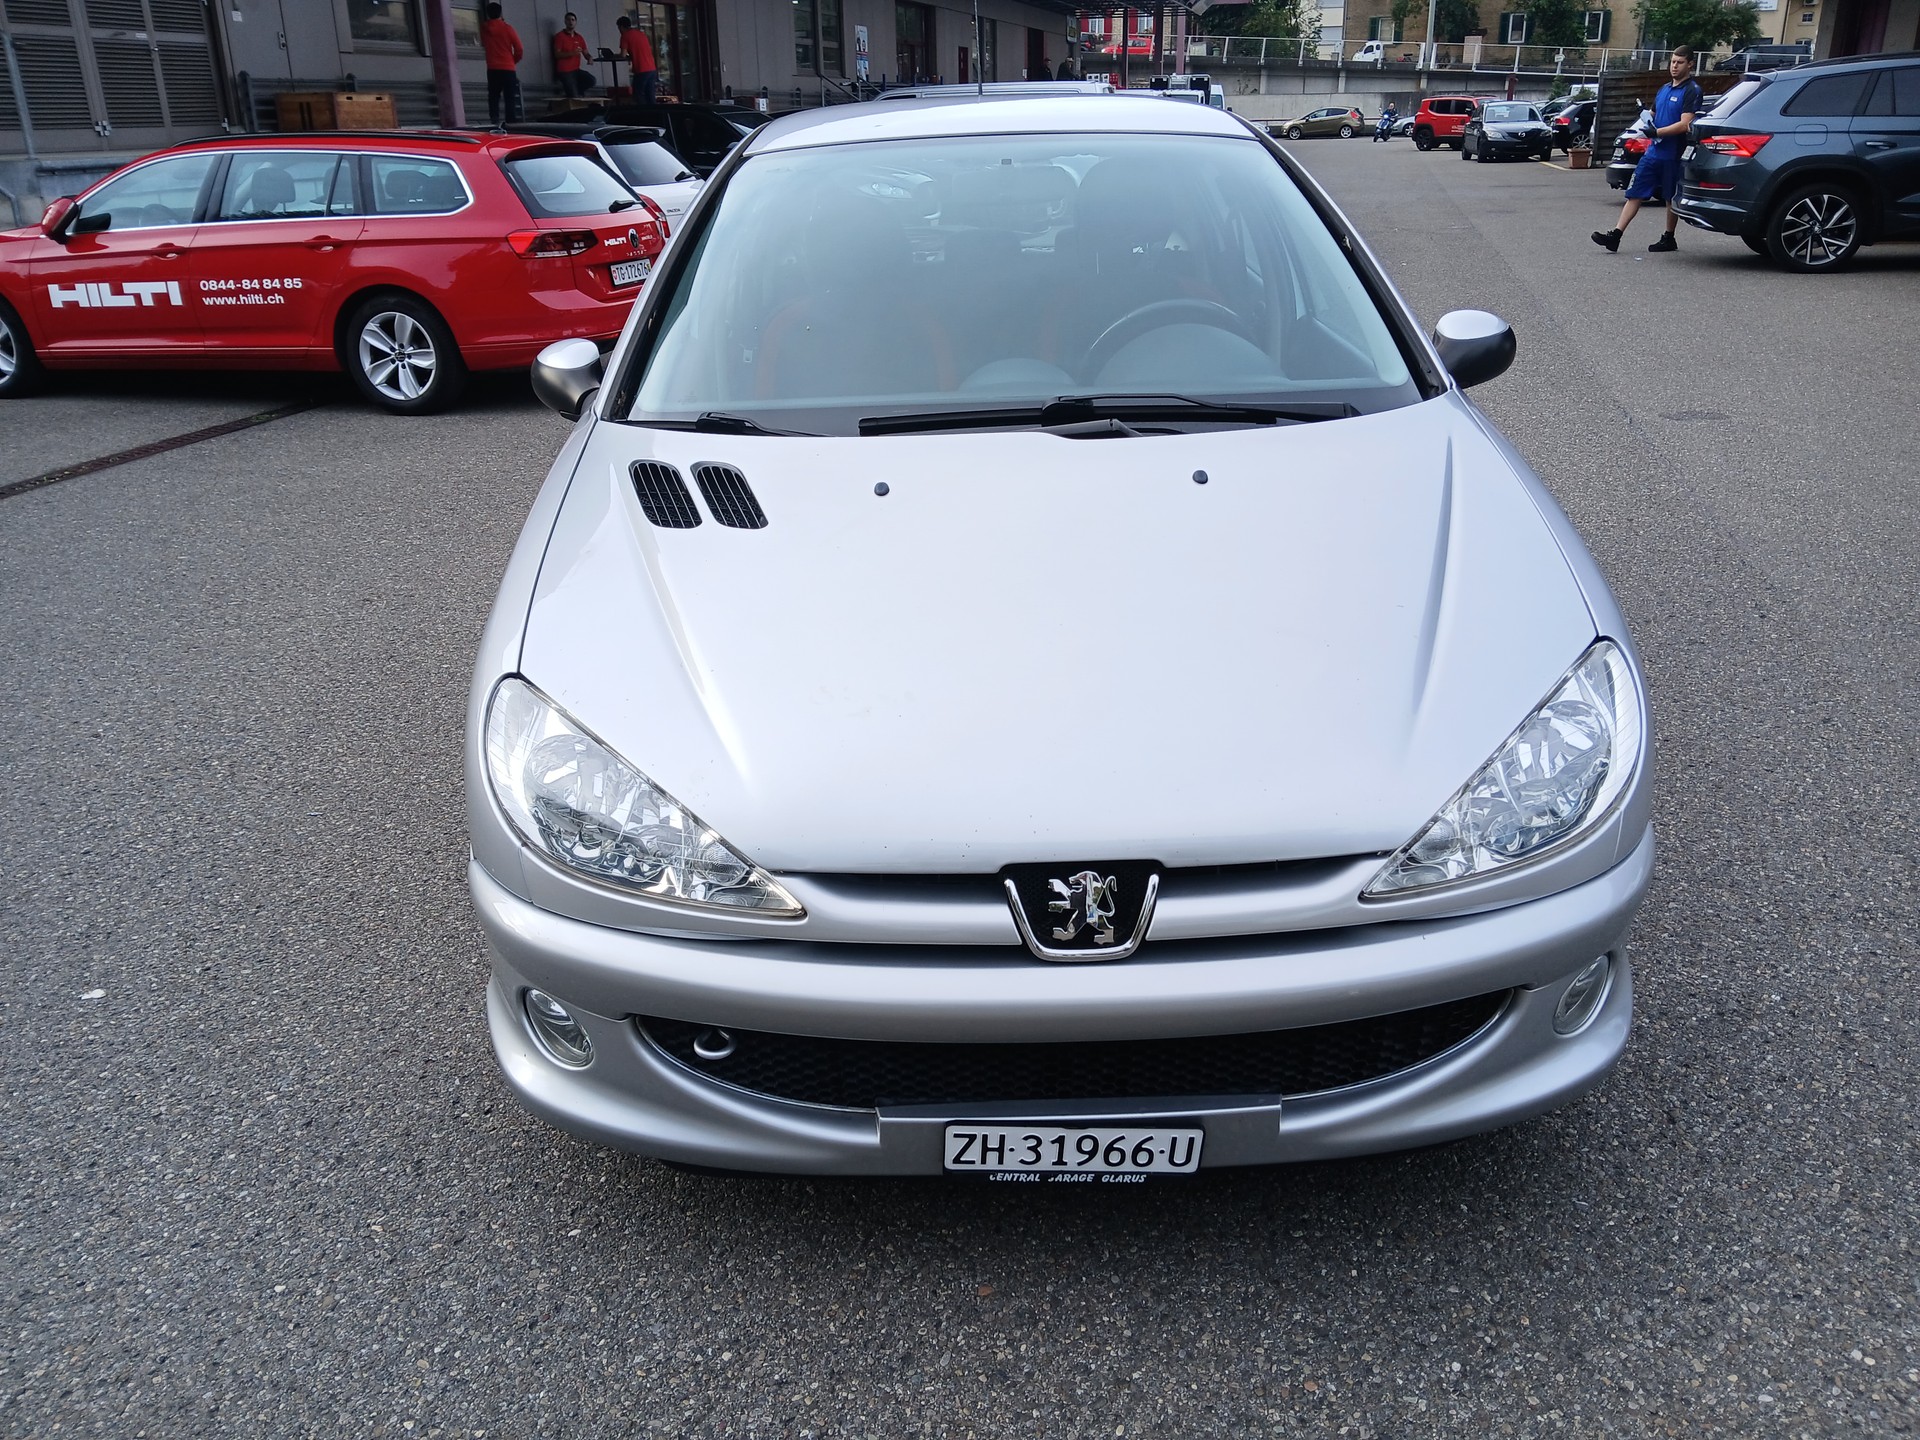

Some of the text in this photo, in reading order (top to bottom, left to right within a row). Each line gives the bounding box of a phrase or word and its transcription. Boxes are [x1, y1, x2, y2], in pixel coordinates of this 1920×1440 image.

[604, 236, 627, 247] HILTI
[200, 278, 303, 291] 0844-84 84 85
[47, 281, 183, 308] HILTI
[202, 293, 285, 305] www.hilti.ch
[1101, 1174, 1147, 1183] GLARUS
